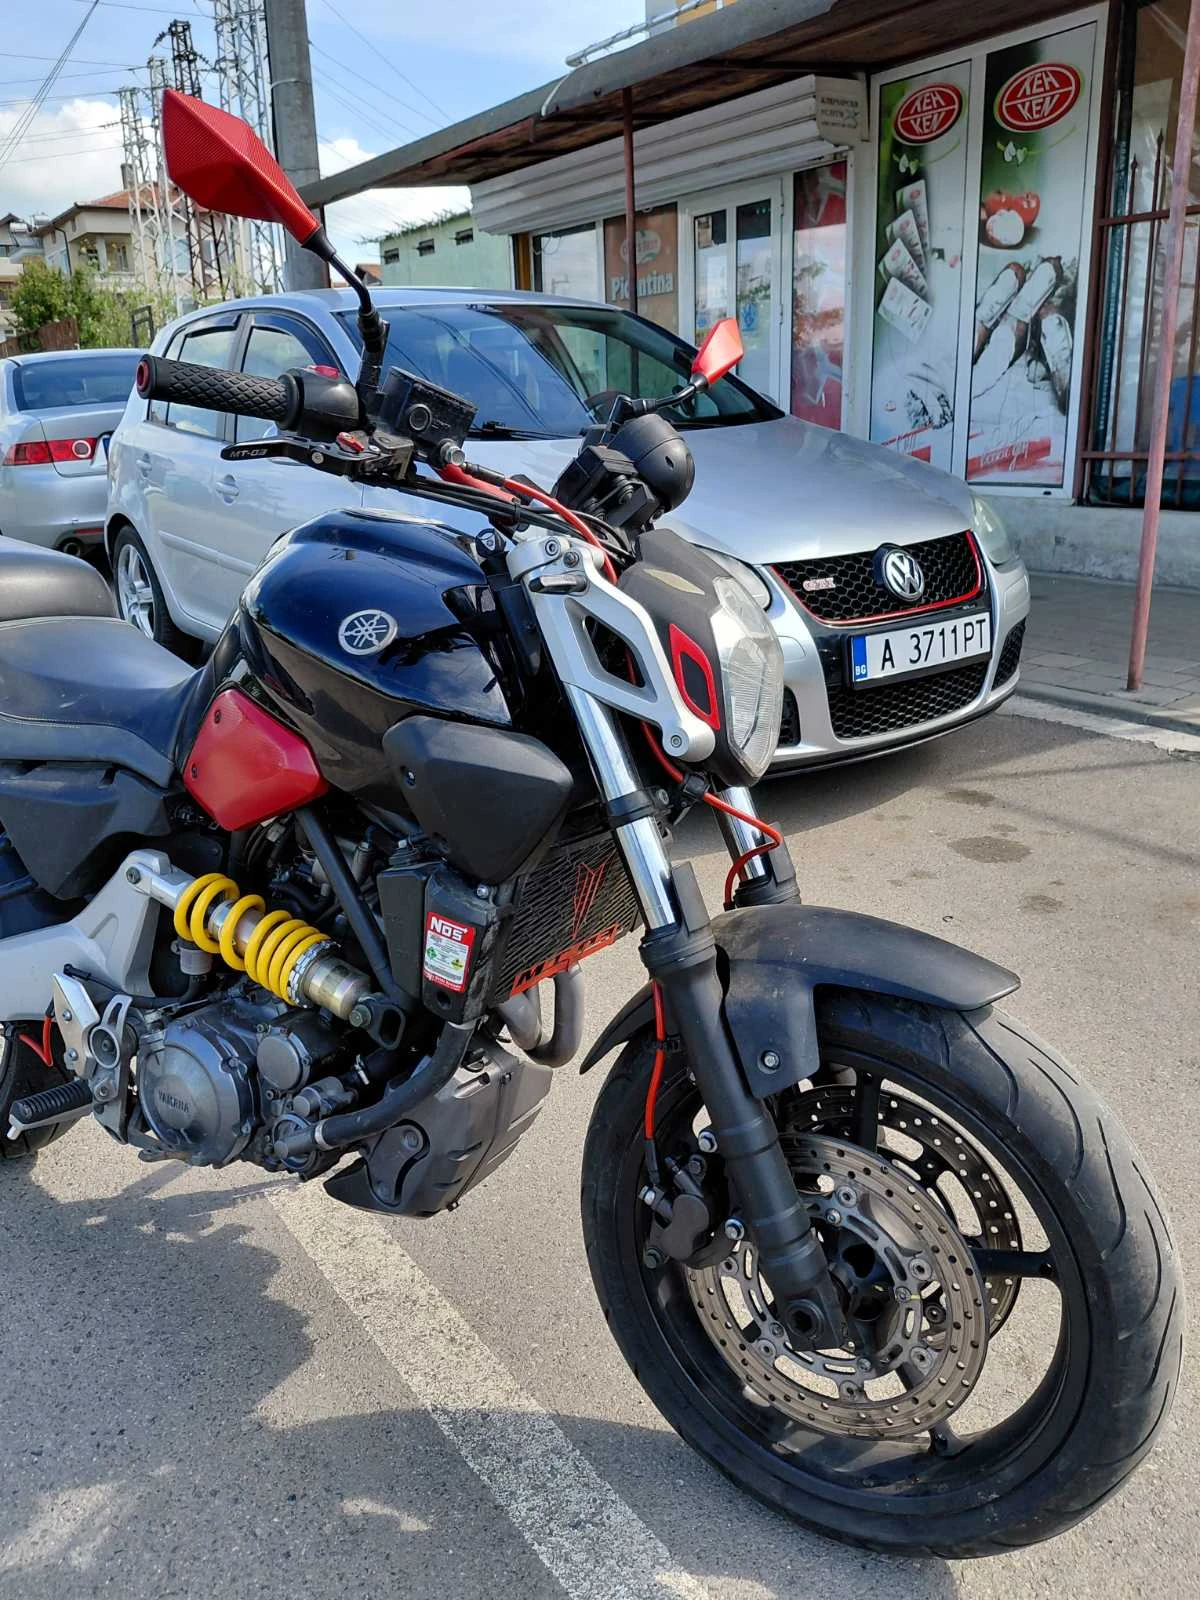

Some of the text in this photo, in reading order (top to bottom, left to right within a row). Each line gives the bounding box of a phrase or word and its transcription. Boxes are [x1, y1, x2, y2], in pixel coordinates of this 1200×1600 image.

[611, 270, 674, 302] Picntina
[229, 448, 268, 458] MT-03
[881, 618, 986, 671] A 3711PT
[855, 664, 867, 676] BG
[430, 916, 463, 942] NOS
